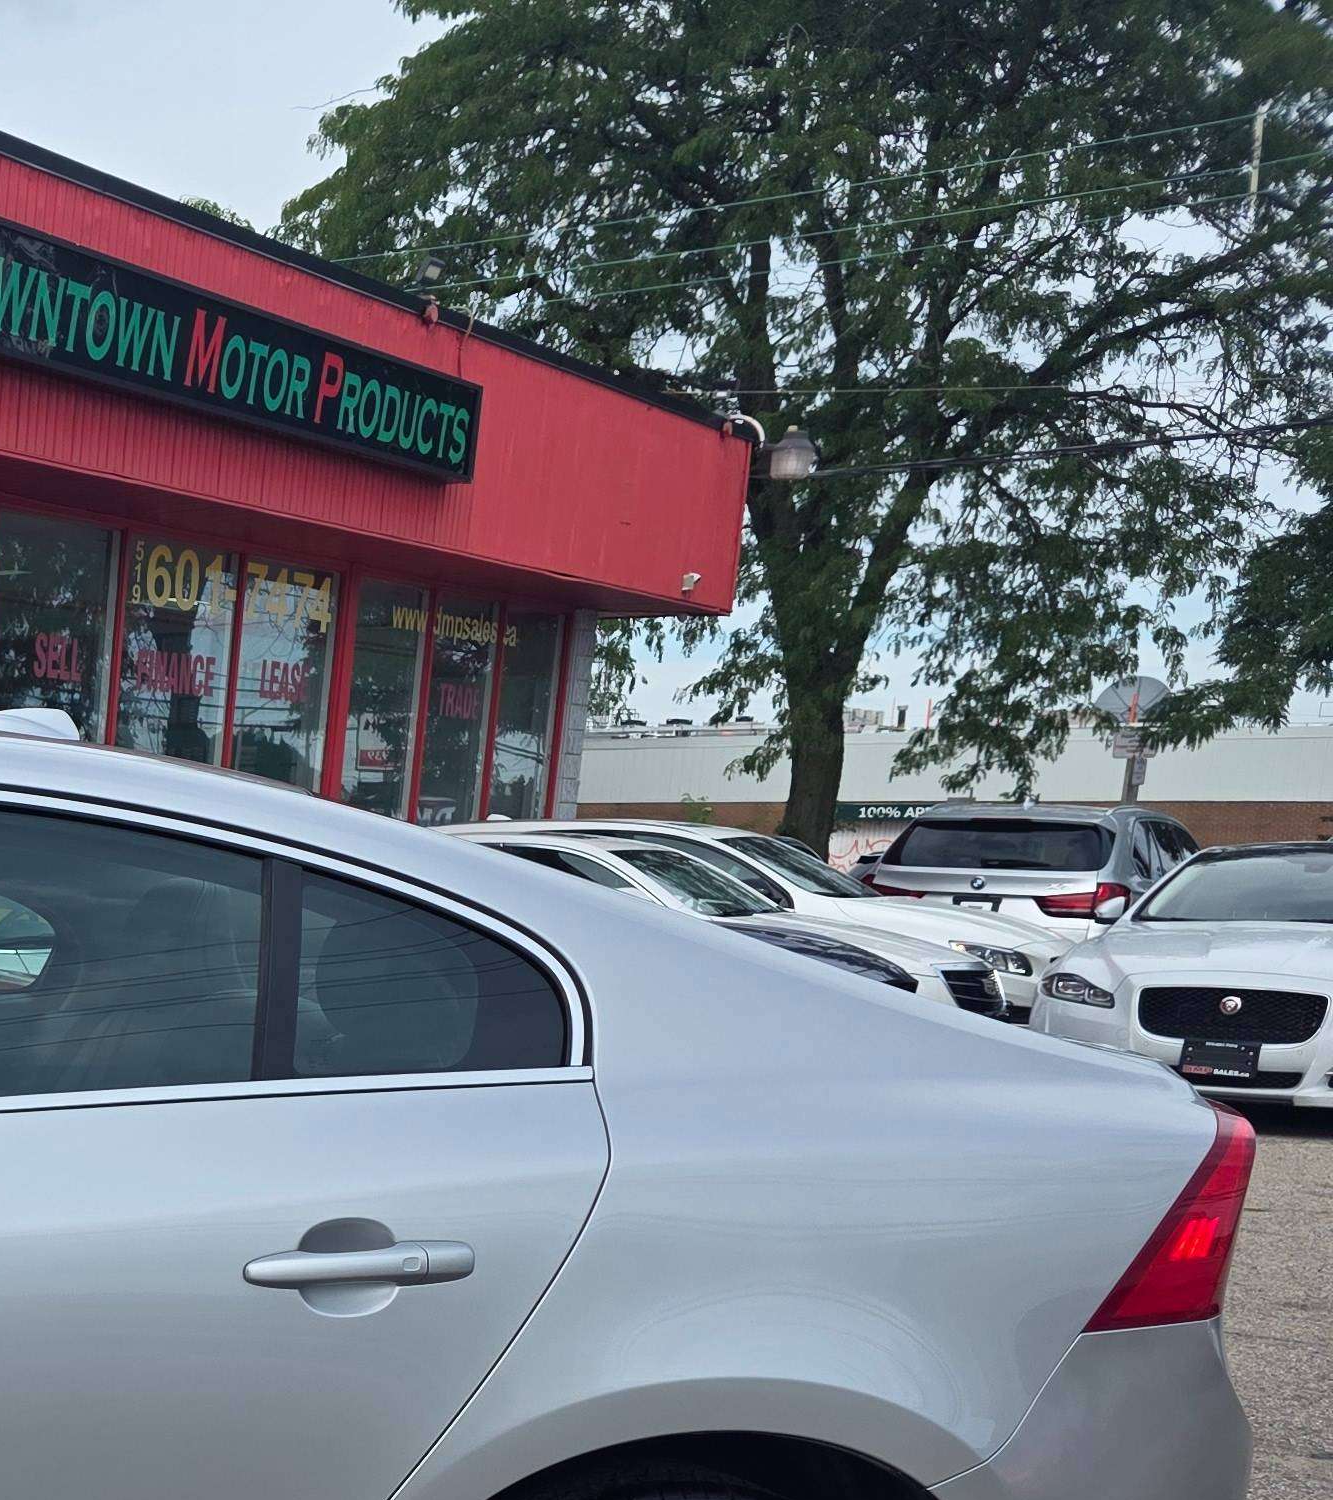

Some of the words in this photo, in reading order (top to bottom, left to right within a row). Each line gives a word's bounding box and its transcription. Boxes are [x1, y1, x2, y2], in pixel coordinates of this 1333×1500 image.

[183, 308, 312, 419] MOTOR
[313, 351, 471, 466] PRODUCTS
[35, 632, 82, 682] SELL
[136, 650, 216, 697] FINANCE
[439, 683, 480, 720] TRADE
[858, 806, 901, 818] 100%
